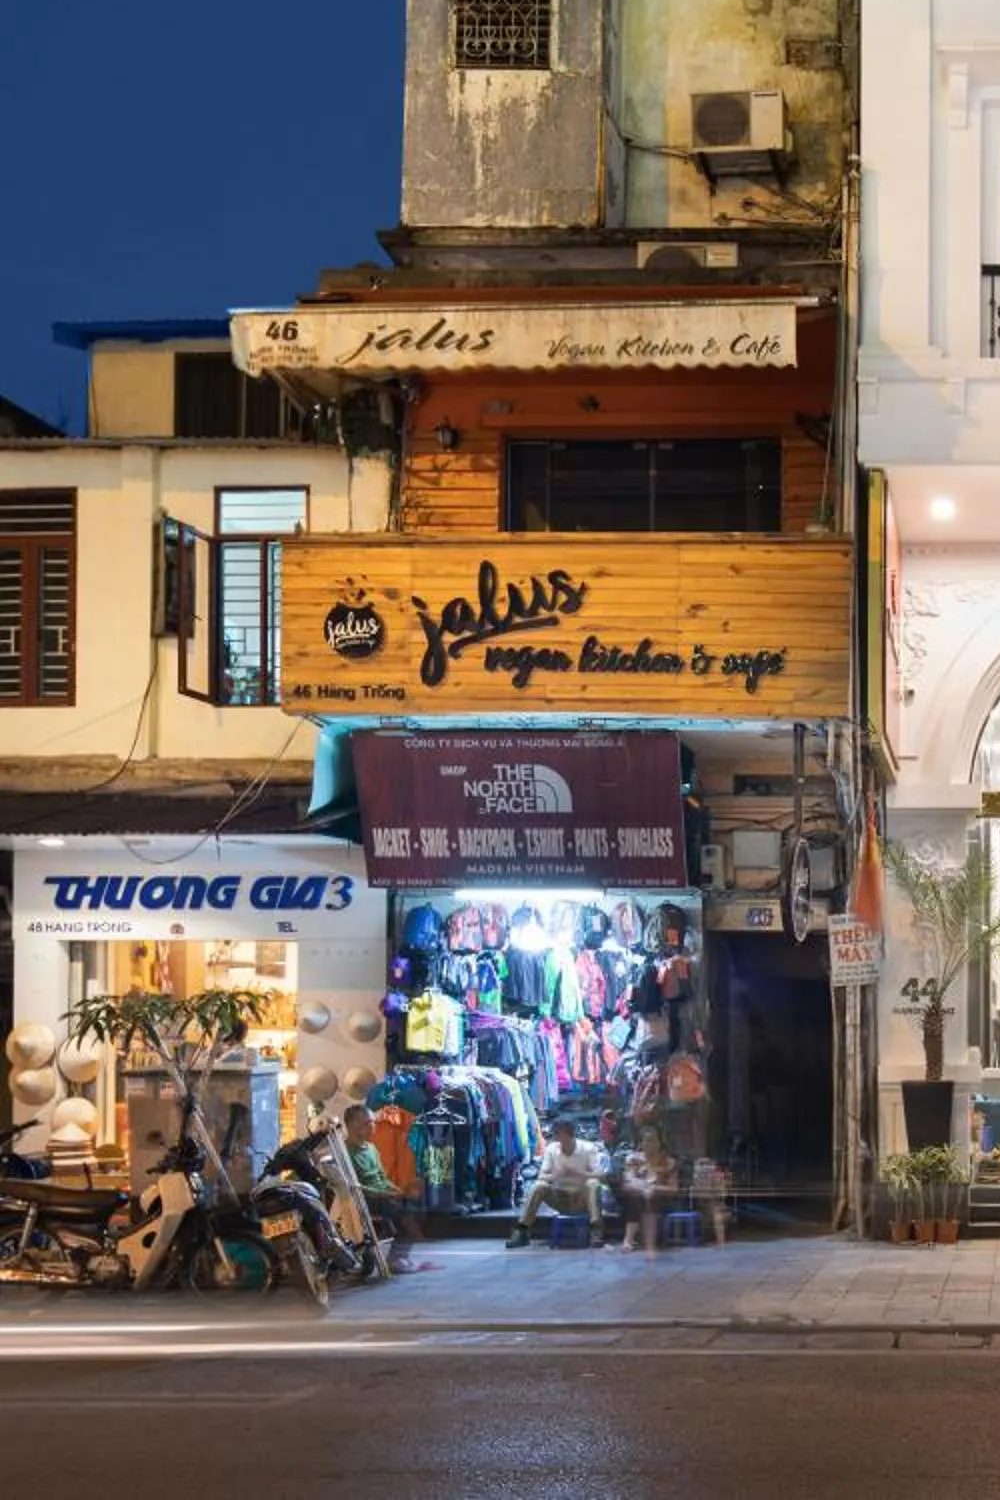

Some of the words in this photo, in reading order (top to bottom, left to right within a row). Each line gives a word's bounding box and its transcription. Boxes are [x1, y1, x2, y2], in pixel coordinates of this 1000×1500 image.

[265, 320, 298, 341] 46
[336, 318, 495, 364] jalus
[615, 334, 695, 358] Kitchen
[729, 332, 782, 361] Café
[327, 611, 380, 648] jalus
[411, 560, 589, 687] jalus
[484, 646, 573, 688] vegan
[577, 635, 685, 673] kitchen
[292, 683, 312, 699] 46
[493, 763, 533, 781] THE
[463, 781, 535, 797] NORTH
[485, 798, 535, 813] FACE
[372, 827, 412, 859] JACKET
[419, 827, 450, 859] SHOE
[458, 827, 517, 858] BACKPACK
[573, 827, 609, 858] PANTS
[617, 827, 675, 858] SUNGLASS
[465, 862, 503, 874] MADE
[525, 862, 586, 874] VIETNAM
[901, 977, 939, 1003] 44
